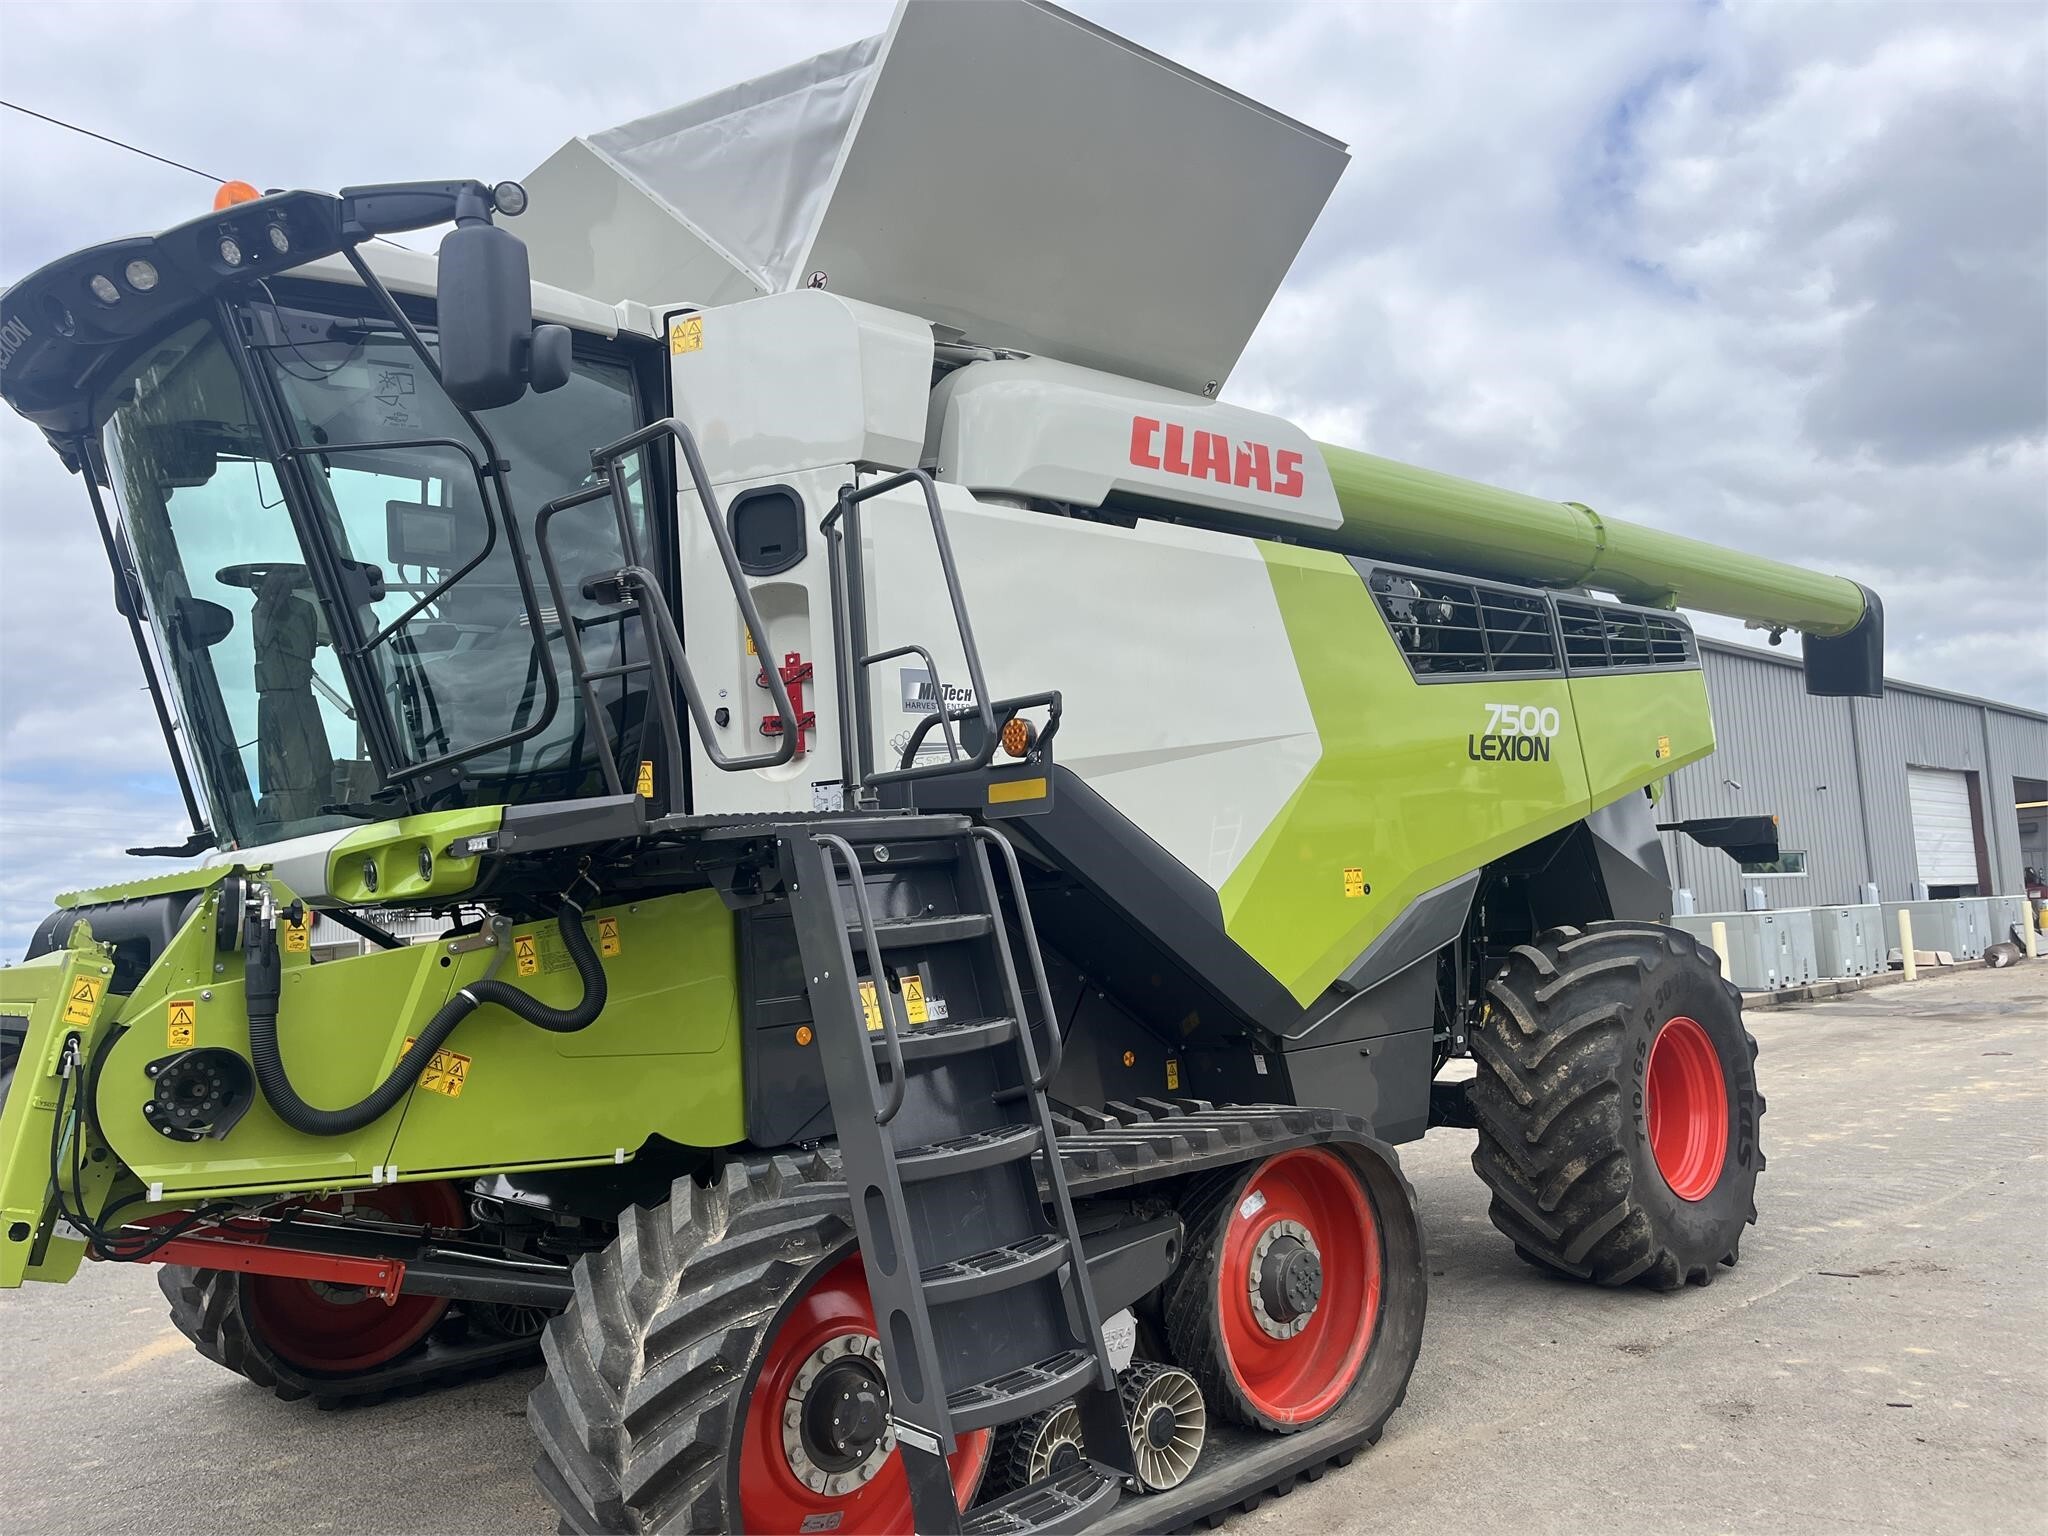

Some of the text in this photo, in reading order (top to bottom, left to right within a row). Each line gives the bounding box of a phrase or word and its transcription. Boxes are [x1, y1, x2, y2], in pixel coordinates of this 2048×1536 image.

[1129, 415, 1304, 498] CLAAS
[905, 701, 938, 710] HARVES
[1484, 703, 1560, 737] 7500
[1468, 734, 1550, 762] LEXION
[1632, 1037, 1646, 1148] 710/65
